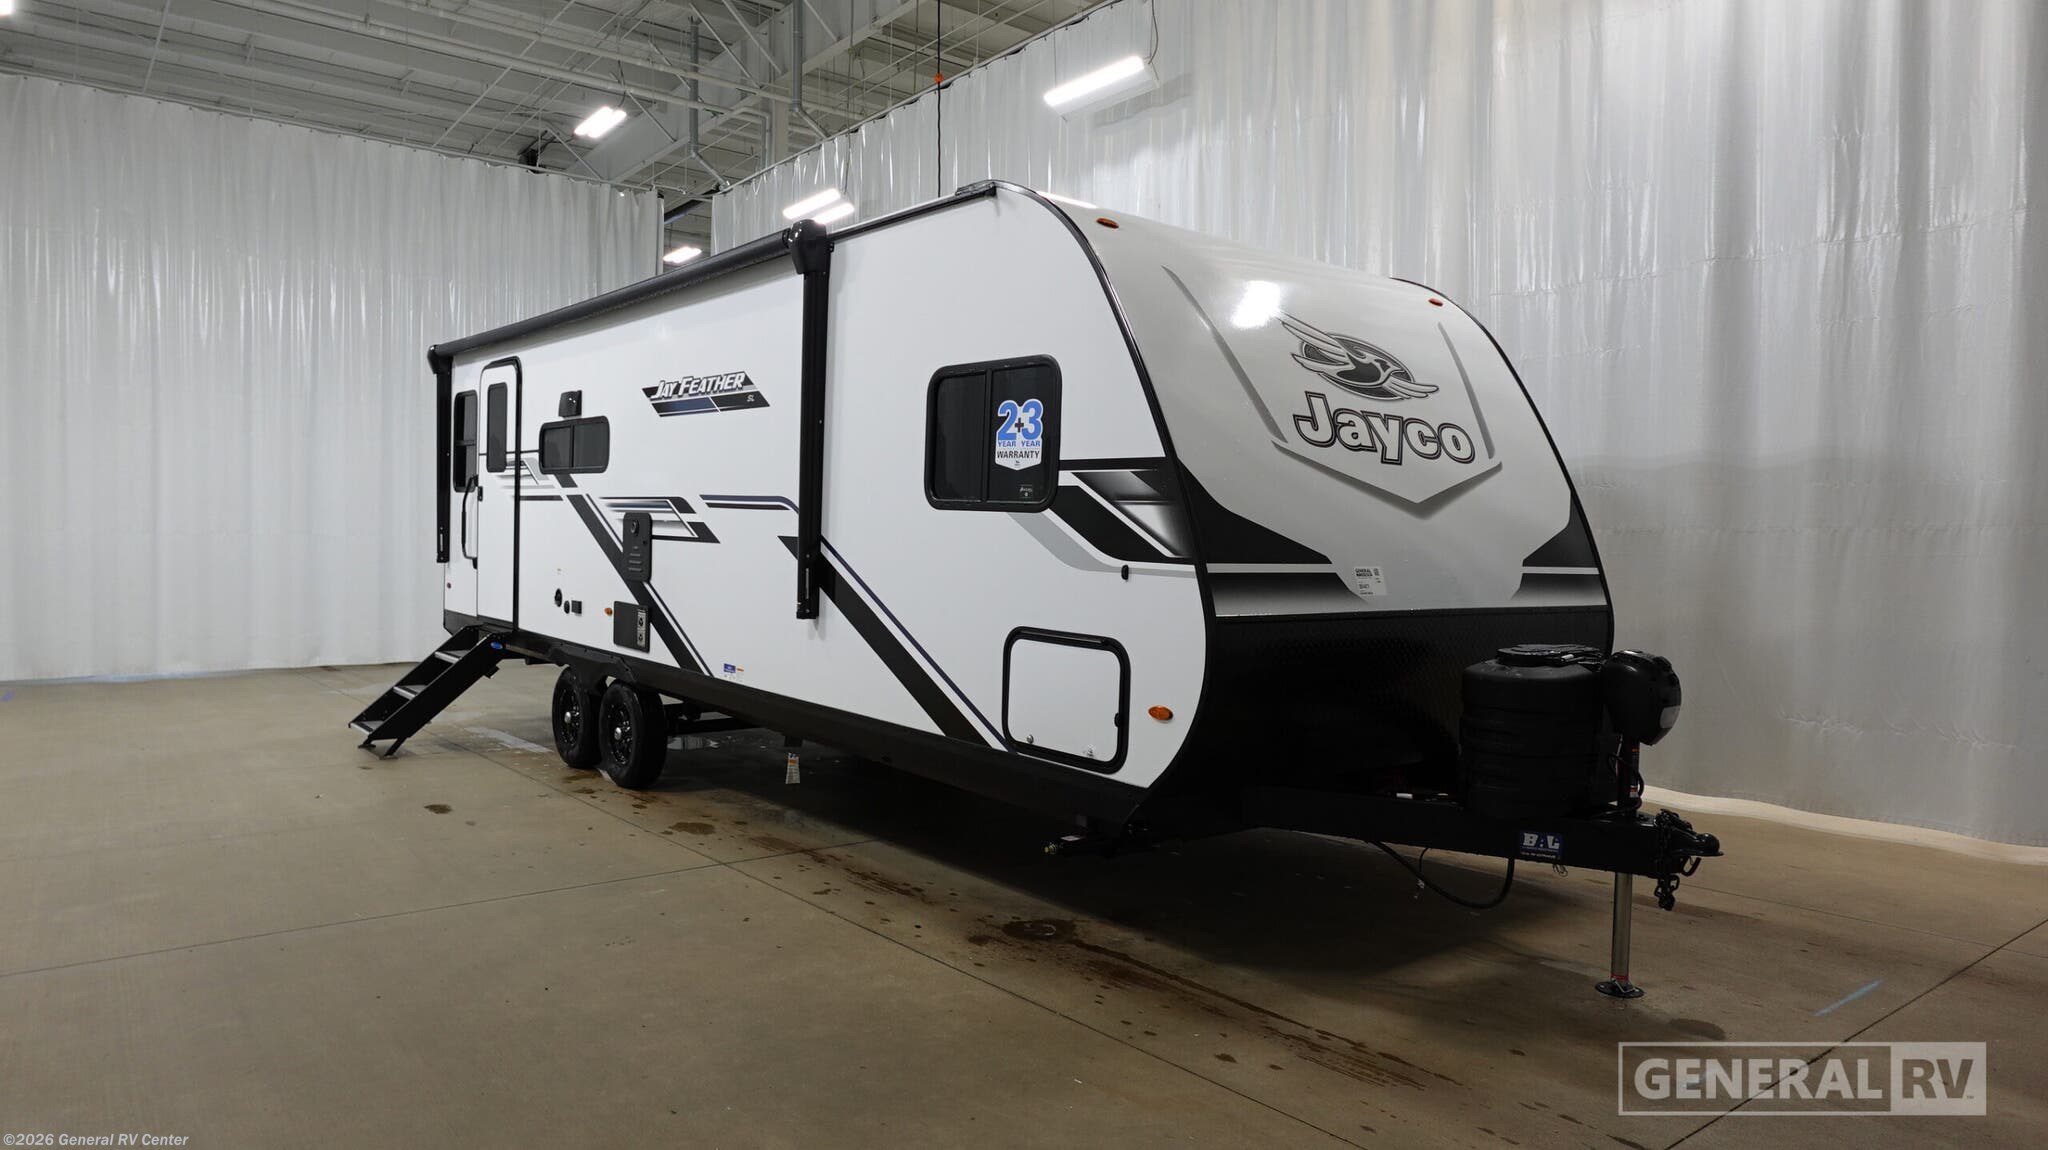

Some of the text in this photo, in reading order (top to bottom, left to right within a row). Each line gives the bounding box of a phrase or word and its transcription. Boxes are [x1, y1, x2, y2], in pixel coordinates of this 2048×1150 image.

[649, 371, 746, 401] JAY FEATHER
[1293, 391, 1475, 465] Jayco
[997, 450, 1039, 459] WARRANTY
